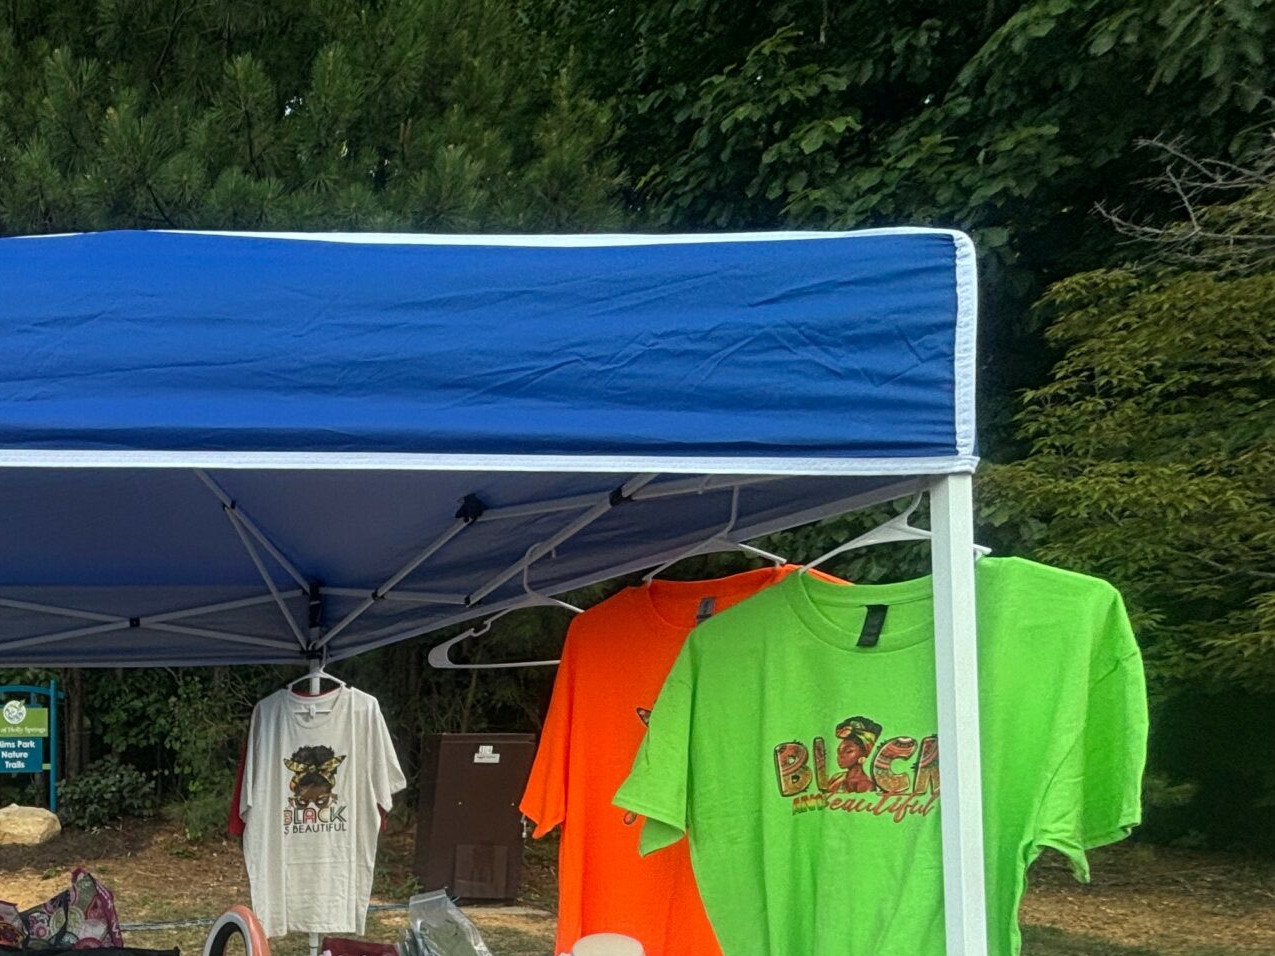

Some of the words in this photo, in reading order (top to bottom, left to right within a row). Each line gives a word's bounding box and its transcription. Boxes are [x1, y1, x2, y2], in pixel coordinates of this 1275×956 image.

[17, 740, 35, 748] Park
[1, 751, 29, 759] Nature
[5, 761, 25, 769] Trails
[283, 806, 347, 825] BLACK
[292, 822, 347, 833] BEAUTIFUL
